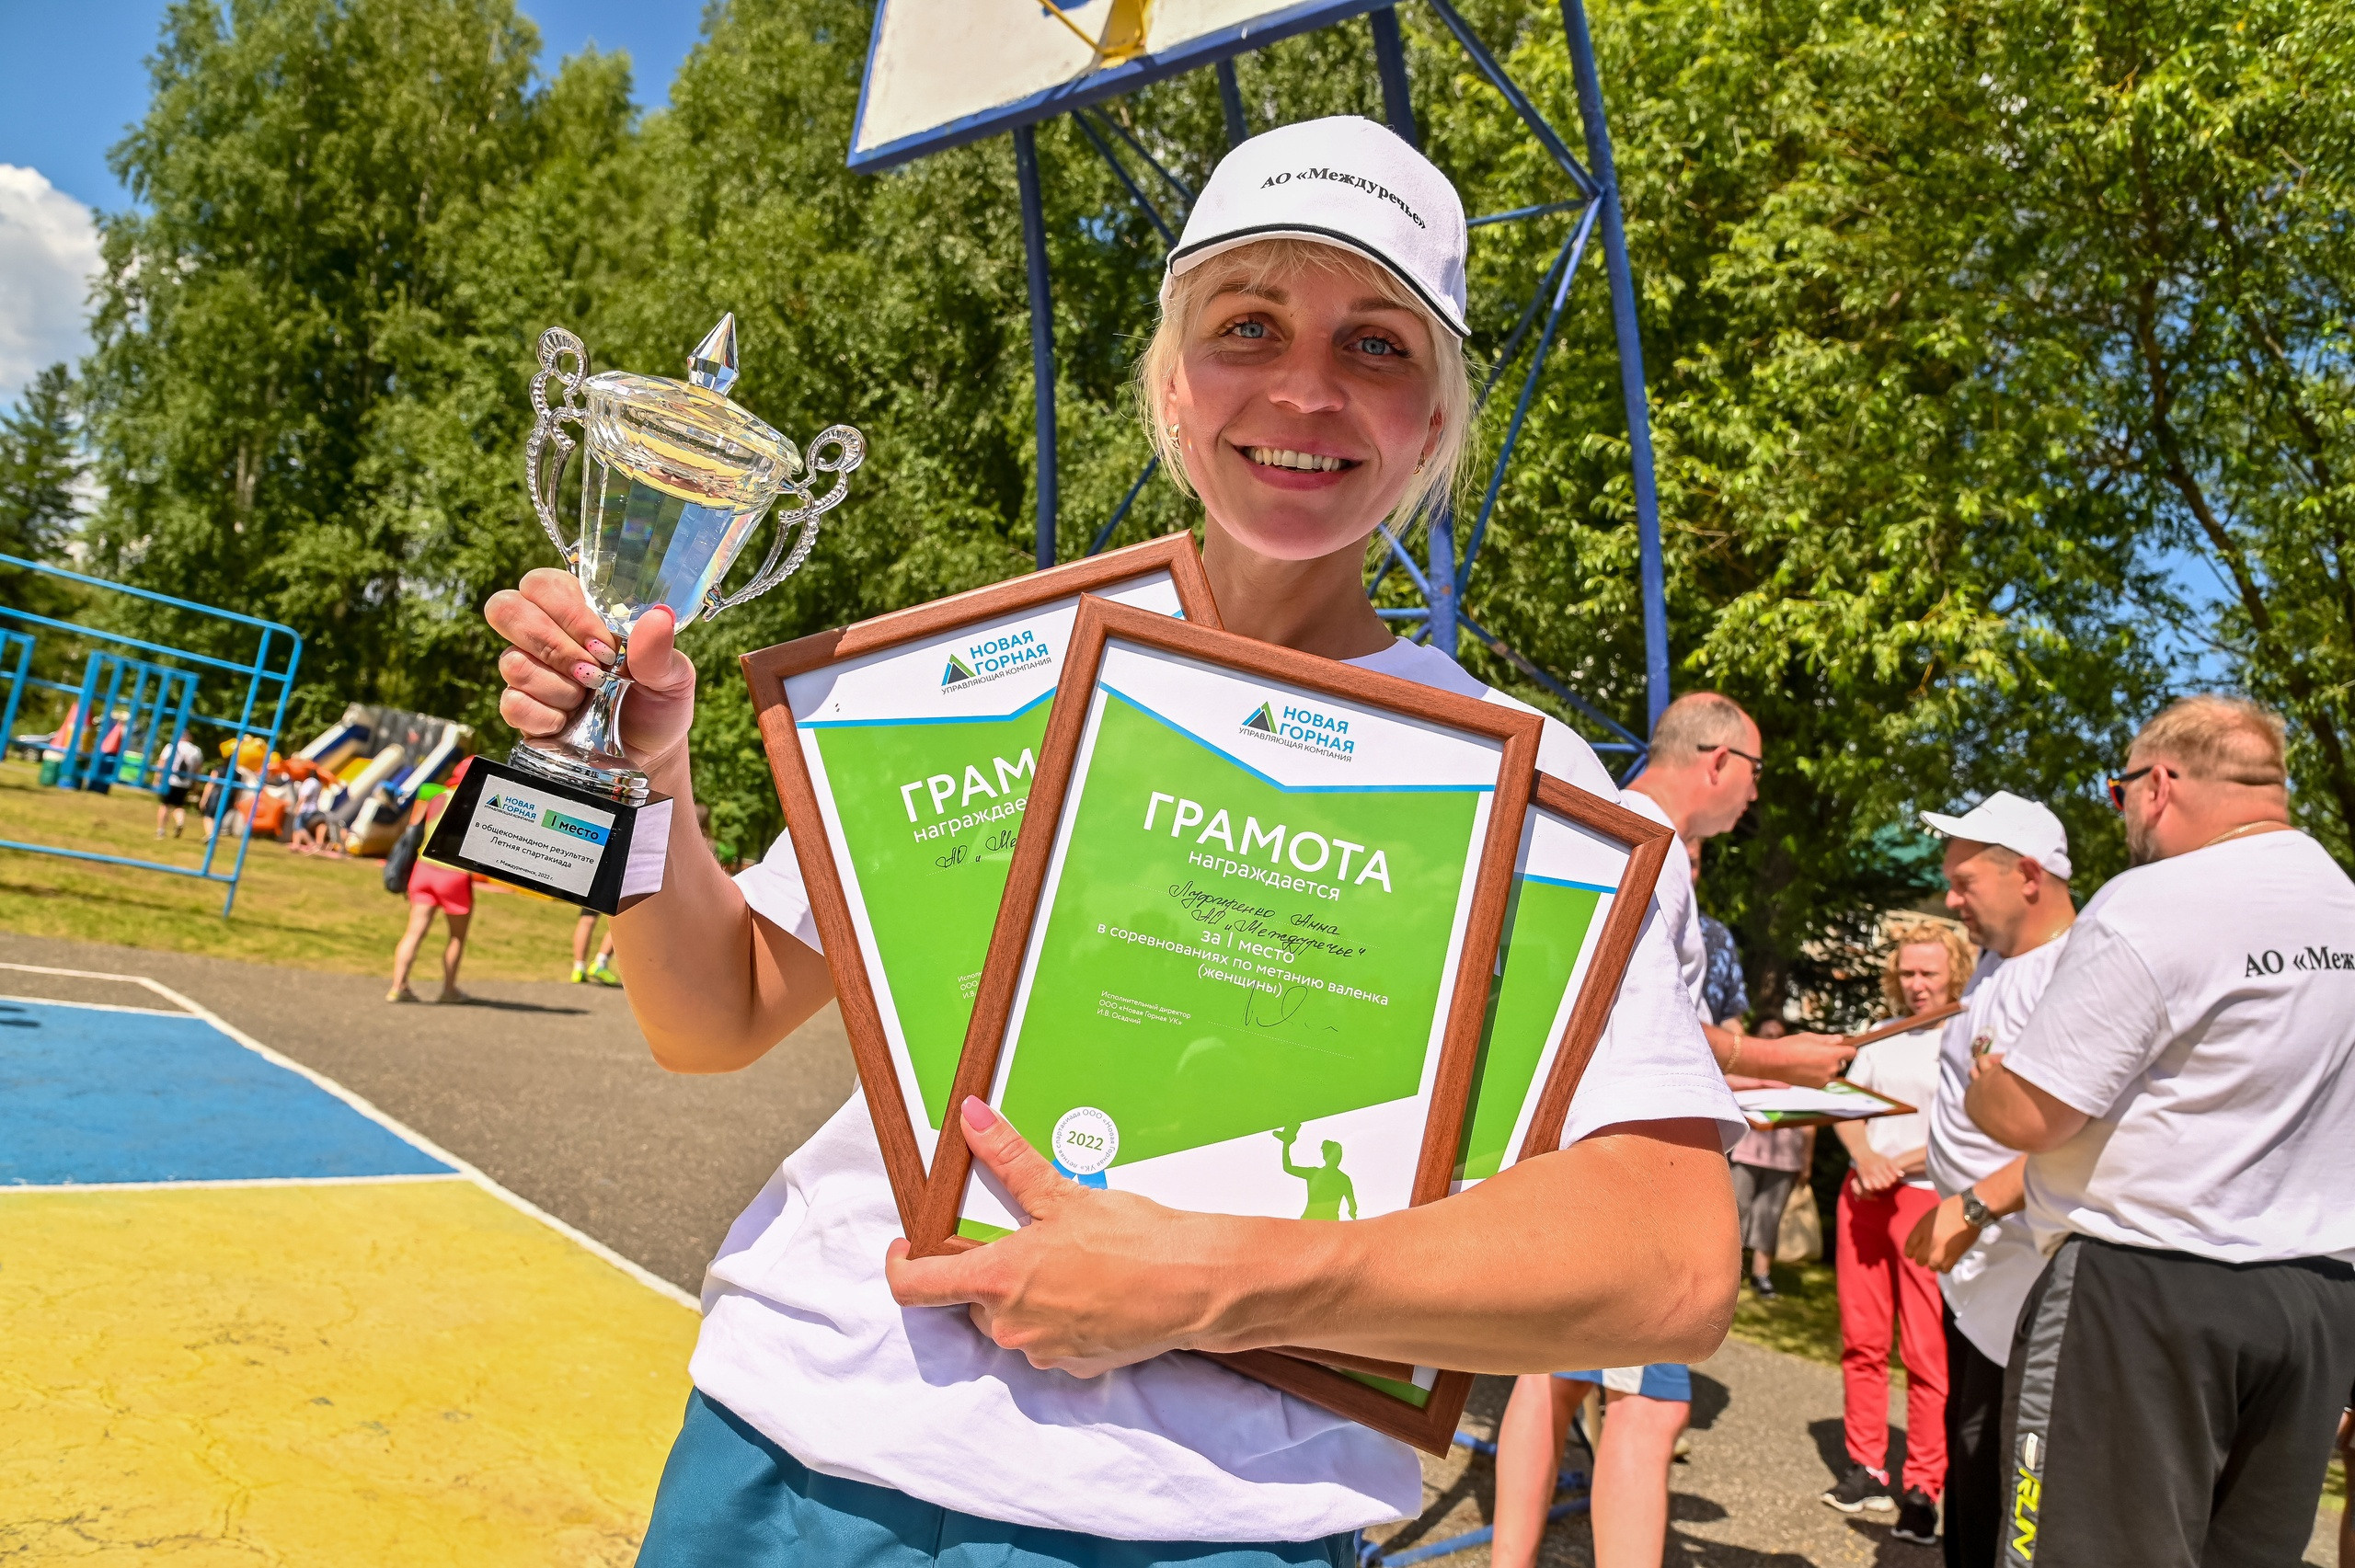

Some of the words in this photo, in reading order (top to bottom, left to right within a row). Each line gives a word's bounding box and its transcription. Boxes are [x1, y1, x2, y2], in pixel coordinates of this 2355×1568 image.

[1260, 172, 1292, 189] АО
[1296, 167, 1426, 229] «Междуречье»
[970, 630, 1034, 659] НОВАЯ
[974, 643, 1049, 675] ГОРНАЯ
[941, 671, 1005, 694] УПРАВЛЯЮЩАЯ
[1005, 658, 1051, 676] КОМПАНИЯ
[1283, 705, 1349, 734] НОВАЯ
[1238, 727, 1304, 750] УПРАВЛЯЮЩАЯ
[1304, 744, 1351, 762] КОМПАНИЯ
[1279, 723, 1355, 753] ГОРНАЯ
[900, 747, 1037, 823] ГРАМ
[502, 803, 537, 819] ГОРНАЯ
[505, 795, 534, 810] НОВАЯ
[558, 820, 599, 840] место
[913, 796, 1028, 843] награждае
[481, 824, 549, 850] общекомандном
[549, 845, 594, 864] результате
[490, 836, 521, 852] Летняя
[522, 848, 572, 868] спартакиада
[1143, 791, 1392, 893] ГРАМОТА
[537, 871, 550, 880] 2022
[1189, 850, 1340, 901] награждается
[1290, 913, 1339, 935] Анна
[1200, 930, 1221, 945] за
[1238, 939, 1294, 964] место
[1097, 923, 1106, 933] в
[1109, 927, 1229, 965] соревнованиях
[1233, 958, 1252, 970] по
[1256, 964, 1324, 989] метанию
[1327, 981, 1388, 1005] валенка
[2245, 949, 2284, 978] АО
[1198, 963, 1282, 998] (женщины)
[1099, 1000, 1118, 1009] ООО
[1119, 1004, 1143, 1016] «Новая
[1144, 1011, 1167, 1022] Горная
[1168, 1016, 1182, 1025] УК»
[1100, 990, 1158, 1010] Исполнительный
[1159, 1006, 1191, 1019] директор
[1112, 1012, 1141, 1024] Осадчий
[1083, 1109, 1102, 1119] ООО
[1066, 1130, 1104, 1150] 2022
